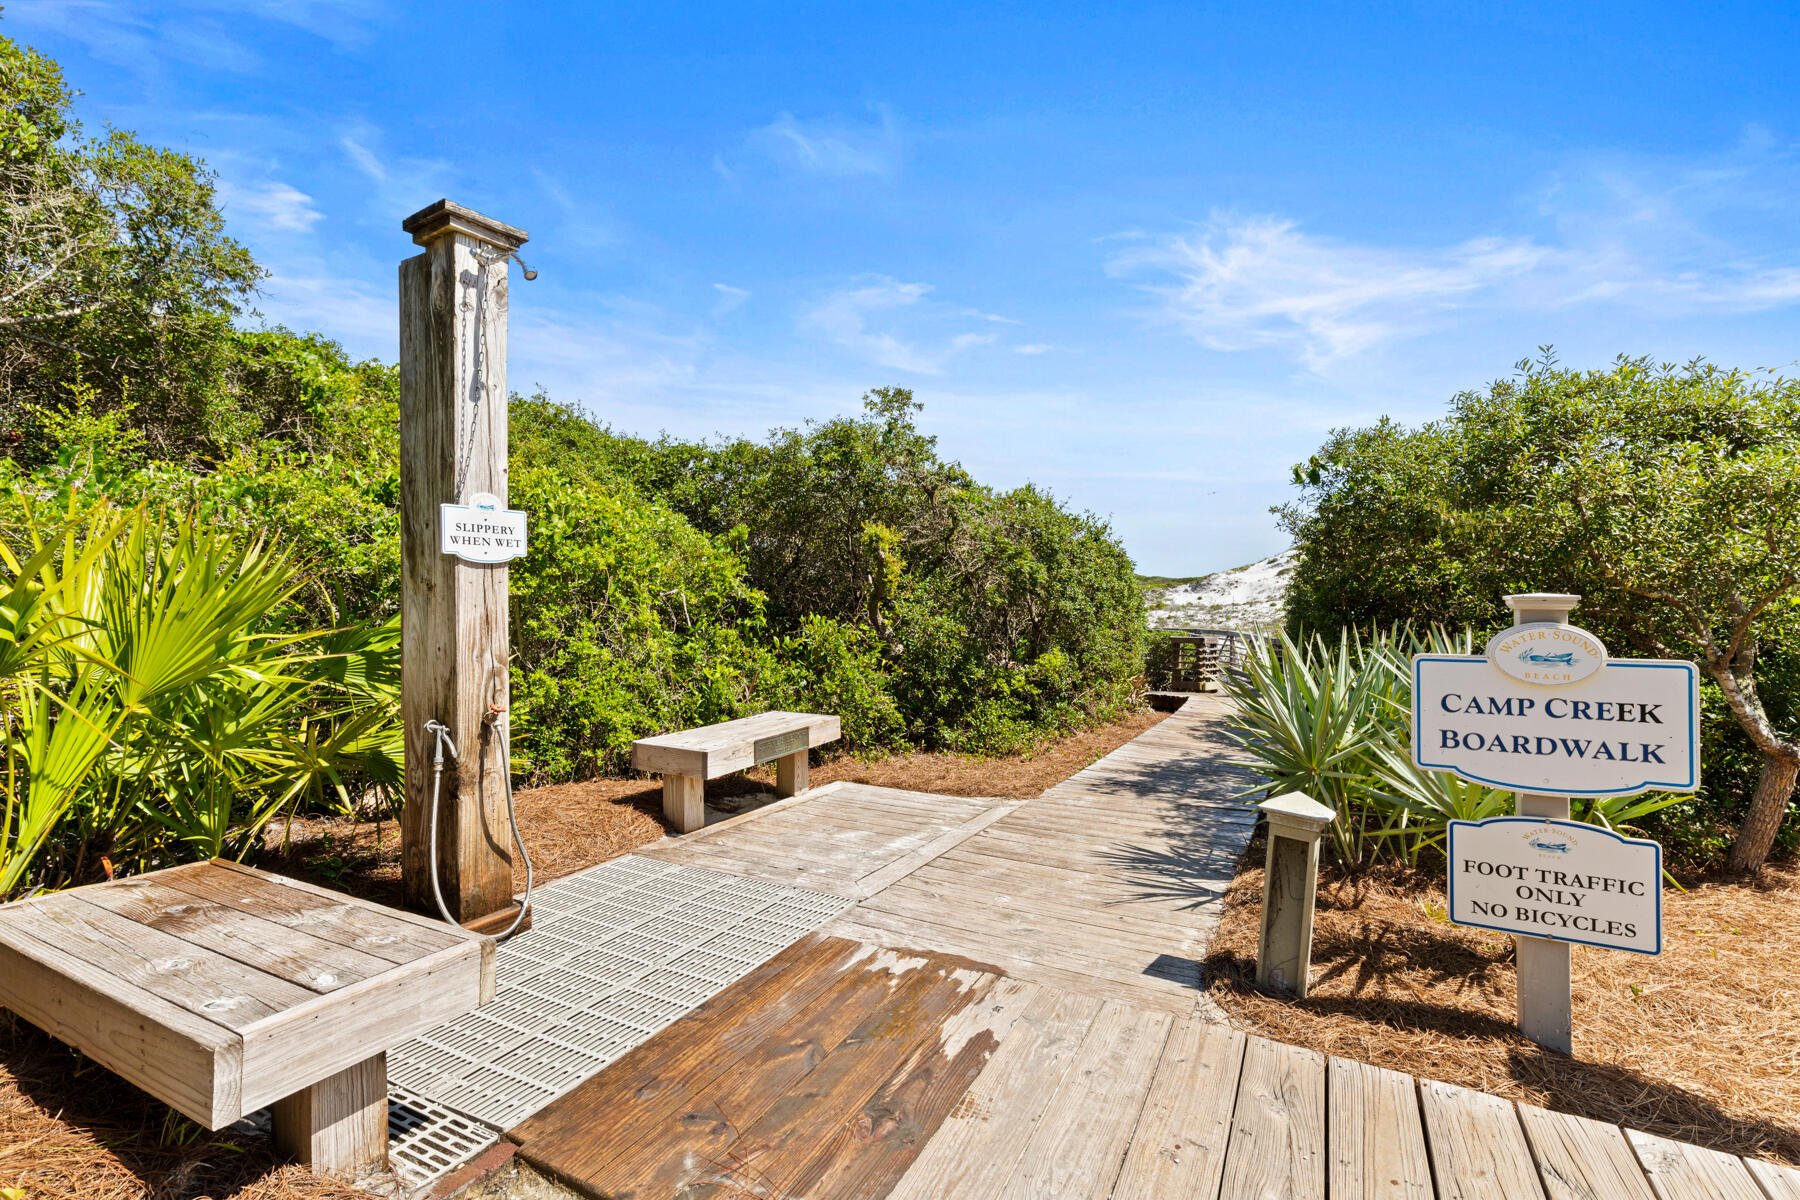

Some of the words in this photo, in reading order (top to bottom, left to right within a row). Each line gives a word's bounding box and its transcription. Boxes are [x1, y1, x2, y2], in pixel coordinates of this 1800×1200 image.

[449, 535, 491, 546] WHEN
[495, 538, 522, 548] WET
[455, 522, 516, 535] SLIPPERY
[1524, 672, 1571, 681] BEACH
[1440, 693, 1535, 717] CAMP
[1544, 697, 1664, 725] CREEK
[1439, 729, 1666, 765] BOARDWALK
[1463, 859, 1529, 881] FOOT
[1535, 868, 1646, 897] TRAFFIC
[1516, 885, 1587, 908] ONLY
[1471, 900, 1508, 918] NO
[1515, 906, 1637, 938] BICYCLES
